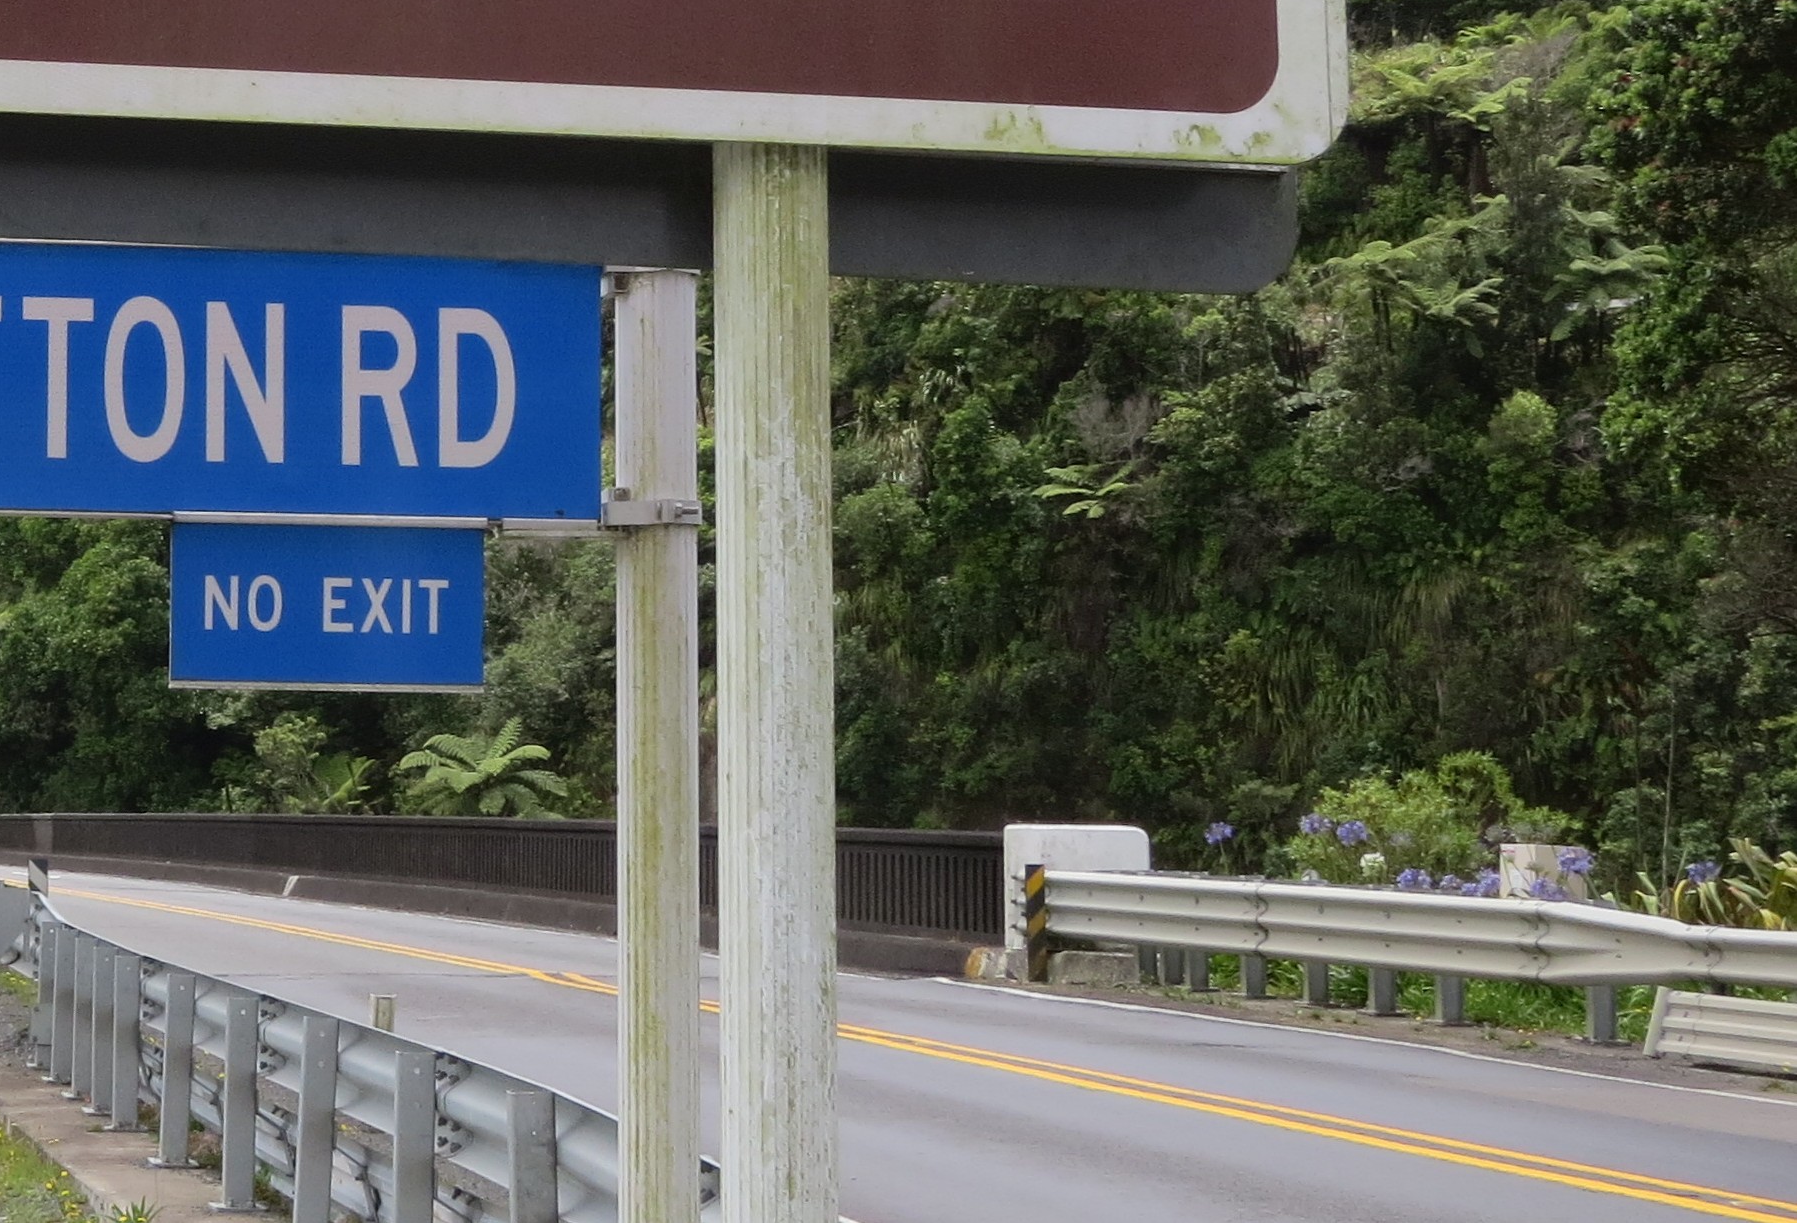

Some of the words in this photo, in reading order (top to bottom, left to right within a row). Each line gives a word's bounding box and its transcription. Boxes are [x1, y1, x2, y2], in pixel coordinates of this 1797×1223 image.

[342, 305, 516, 468] RD
[204, 574, 283, 632] NO
[322, 576, 450, 635] EXIT
